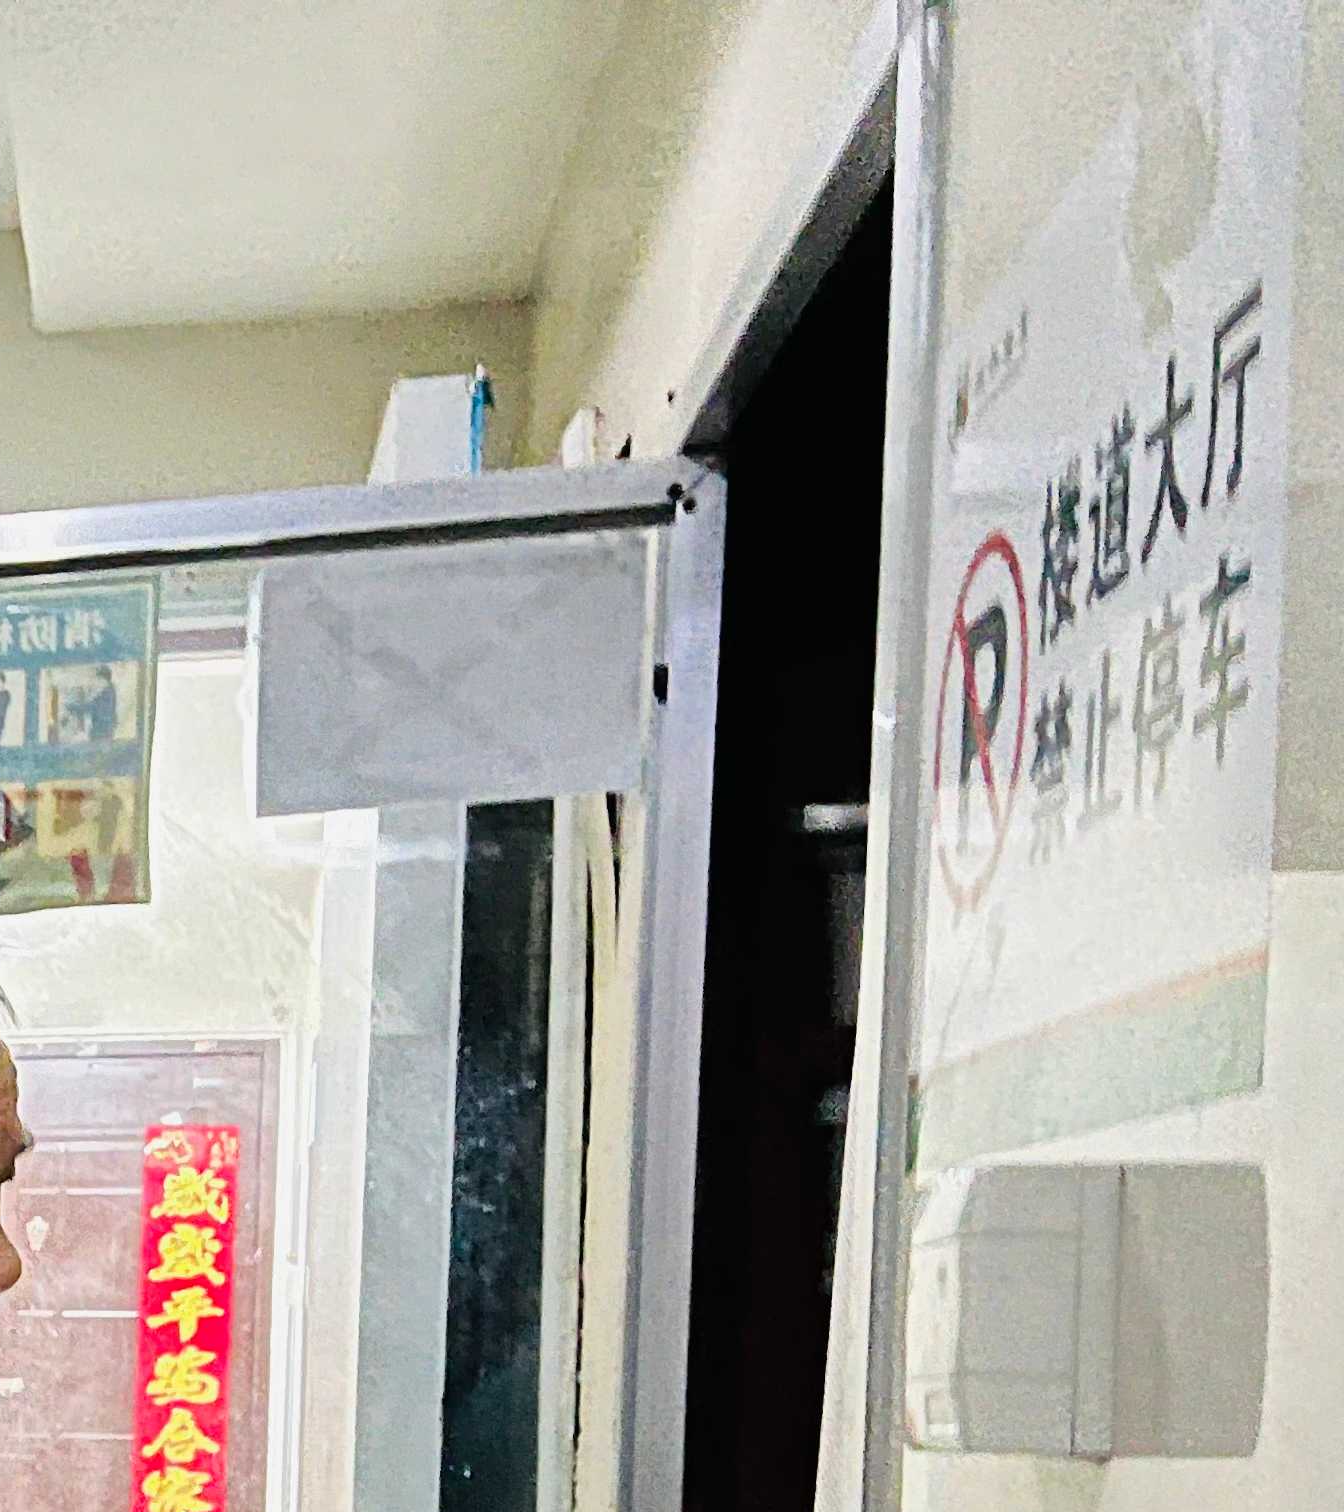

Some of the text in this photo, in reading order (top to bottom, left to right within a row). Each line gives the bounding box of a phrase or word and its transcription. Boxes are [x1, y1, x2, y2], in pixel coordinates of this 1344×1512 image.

[1037, 277, 1263, 655] 楼道大厅
[1029, 549, 1252, 865] 禁止停车
